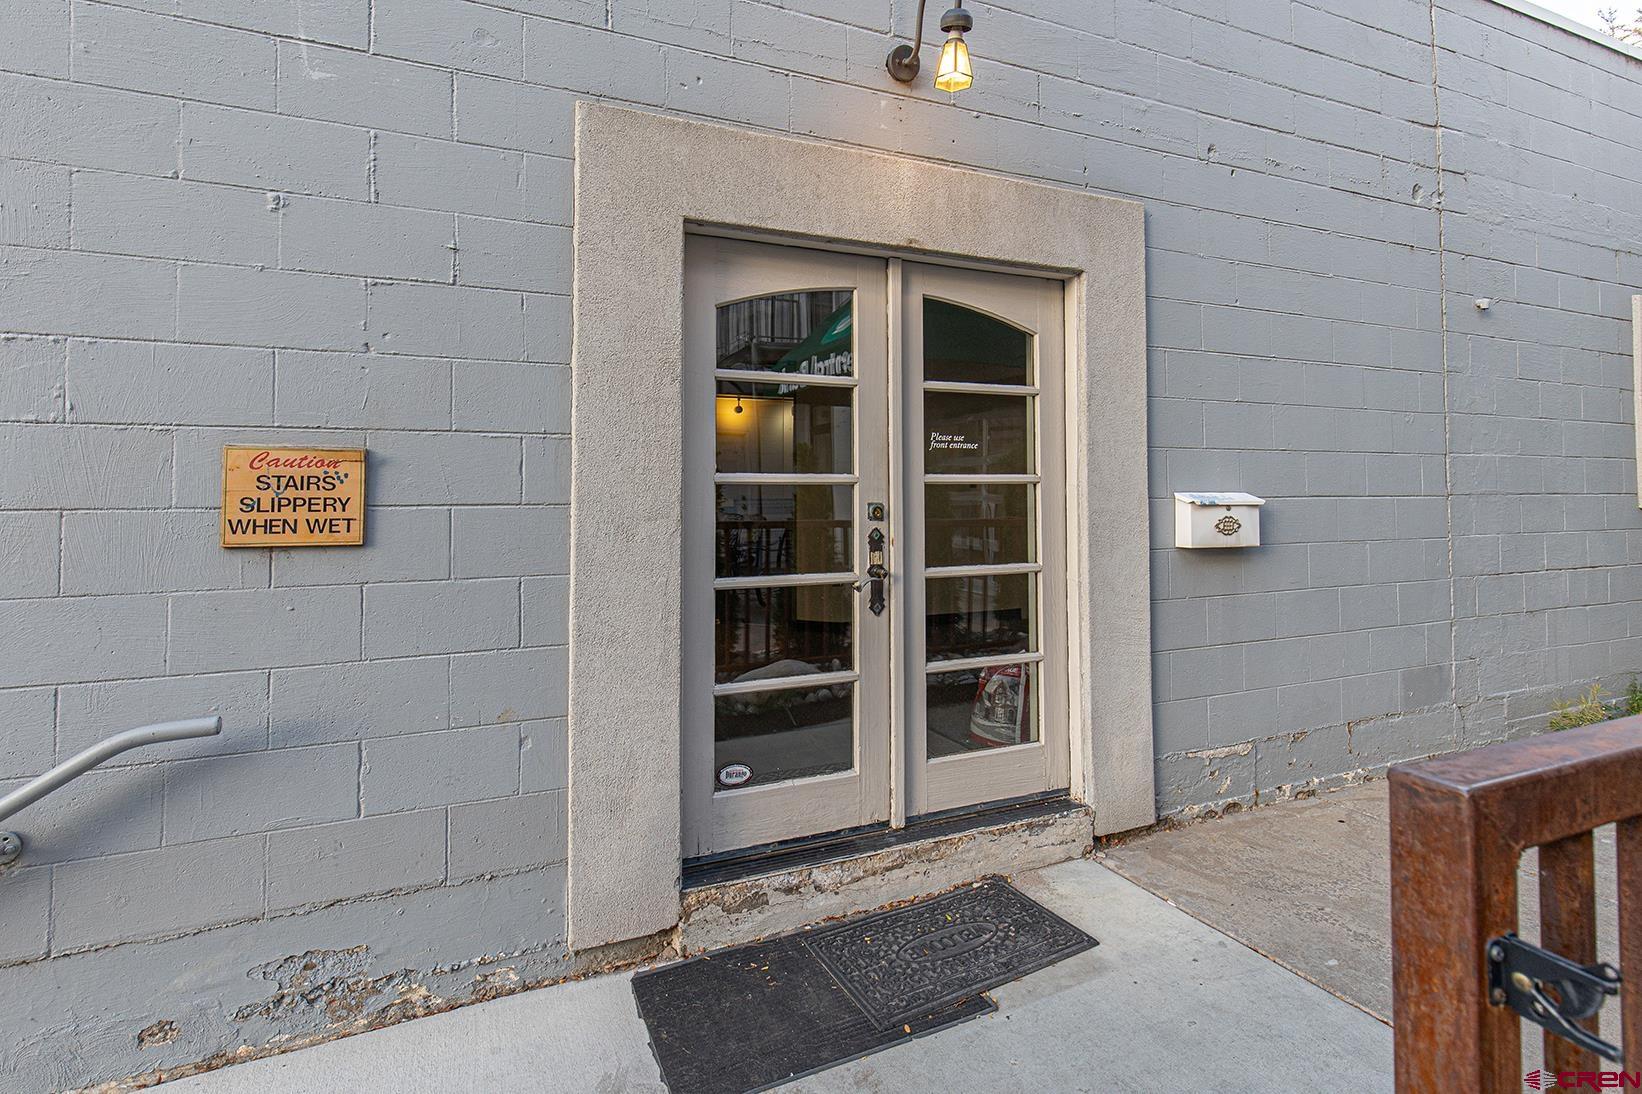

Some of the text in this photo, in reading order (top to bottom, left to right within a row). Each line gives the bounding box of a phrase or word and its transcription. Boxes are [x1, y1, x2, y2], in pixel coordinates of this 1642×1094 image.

[930, 432, 952, 441] Please
[929, 440, 948, 451] front
[249, 451, 343, 471] Caution
[256, 474, 337, 492] STAIRS
[239, 497, 352, 513] SLIPPERY
[228, 517, 357, 535] WHEN WET
